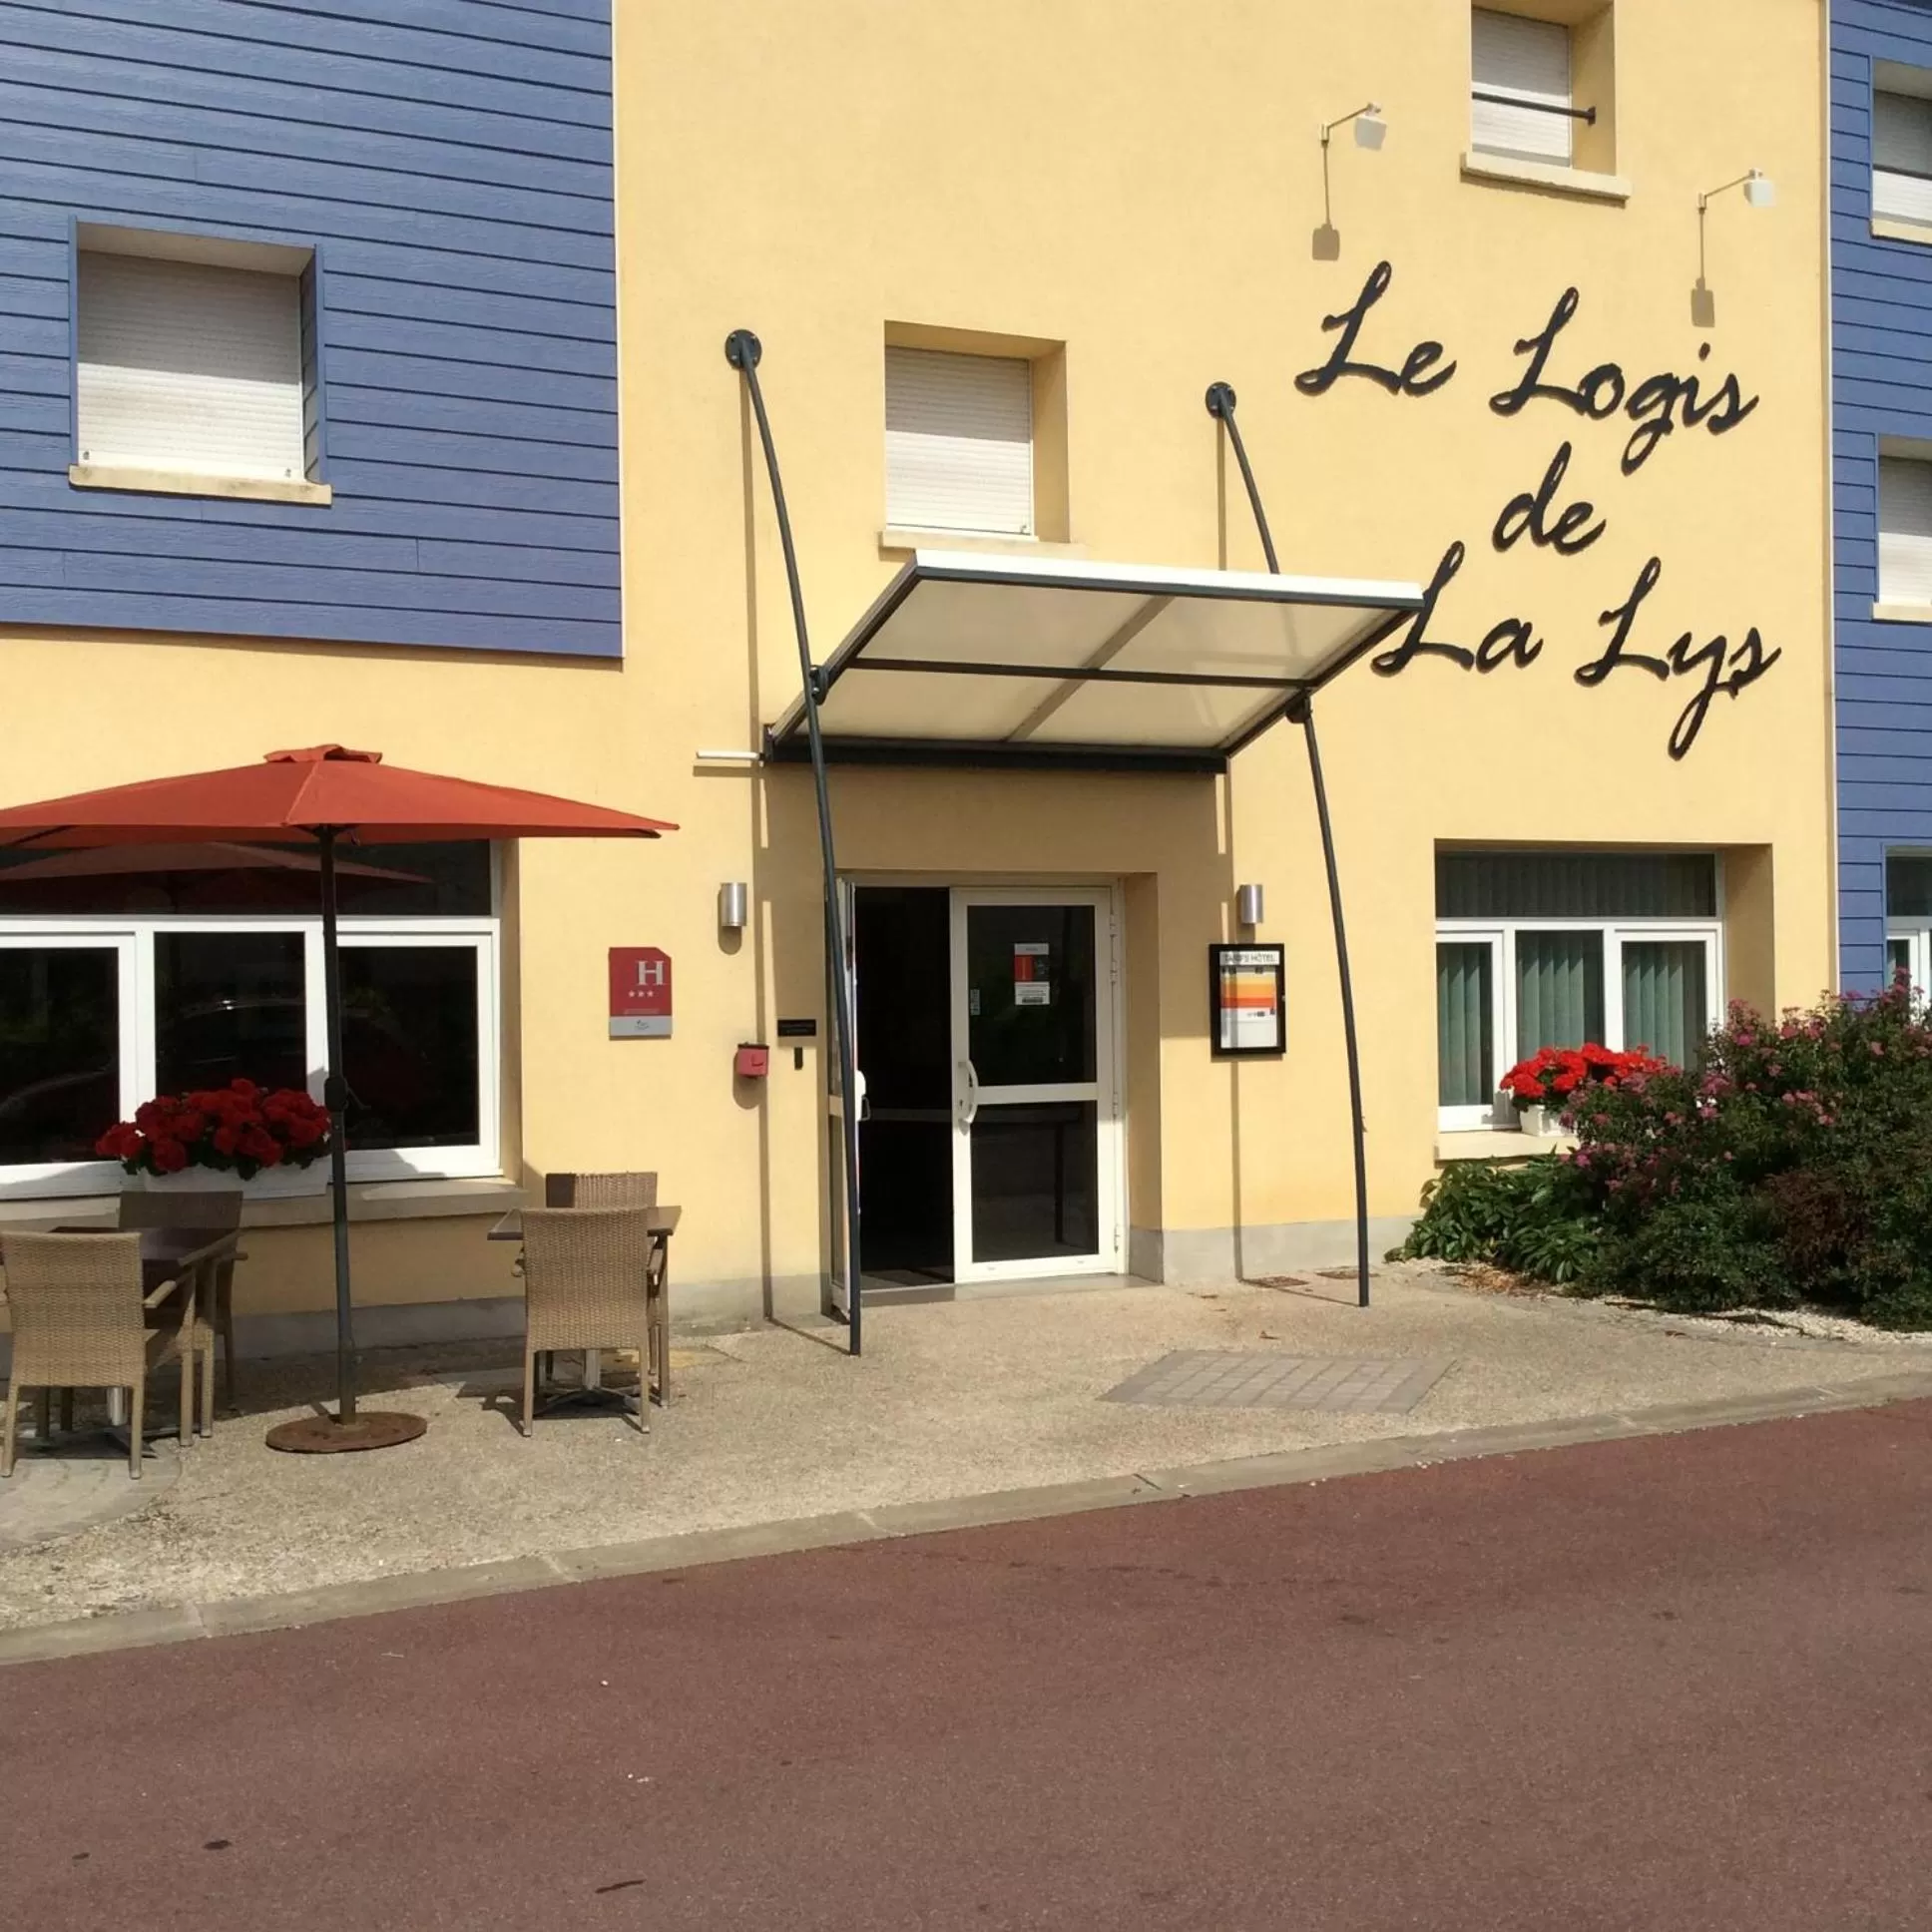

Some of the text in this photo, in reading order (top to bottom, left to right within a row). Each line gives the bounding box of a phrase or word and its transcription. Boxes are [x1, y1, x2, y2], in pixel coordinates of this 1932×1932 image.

[1294, 260, 1759, 476] Le Logis
[1492, 441, 1607, 555] de
[1370, 540, 1782, 761] La Lys
[636, 959, 665, 986] H
